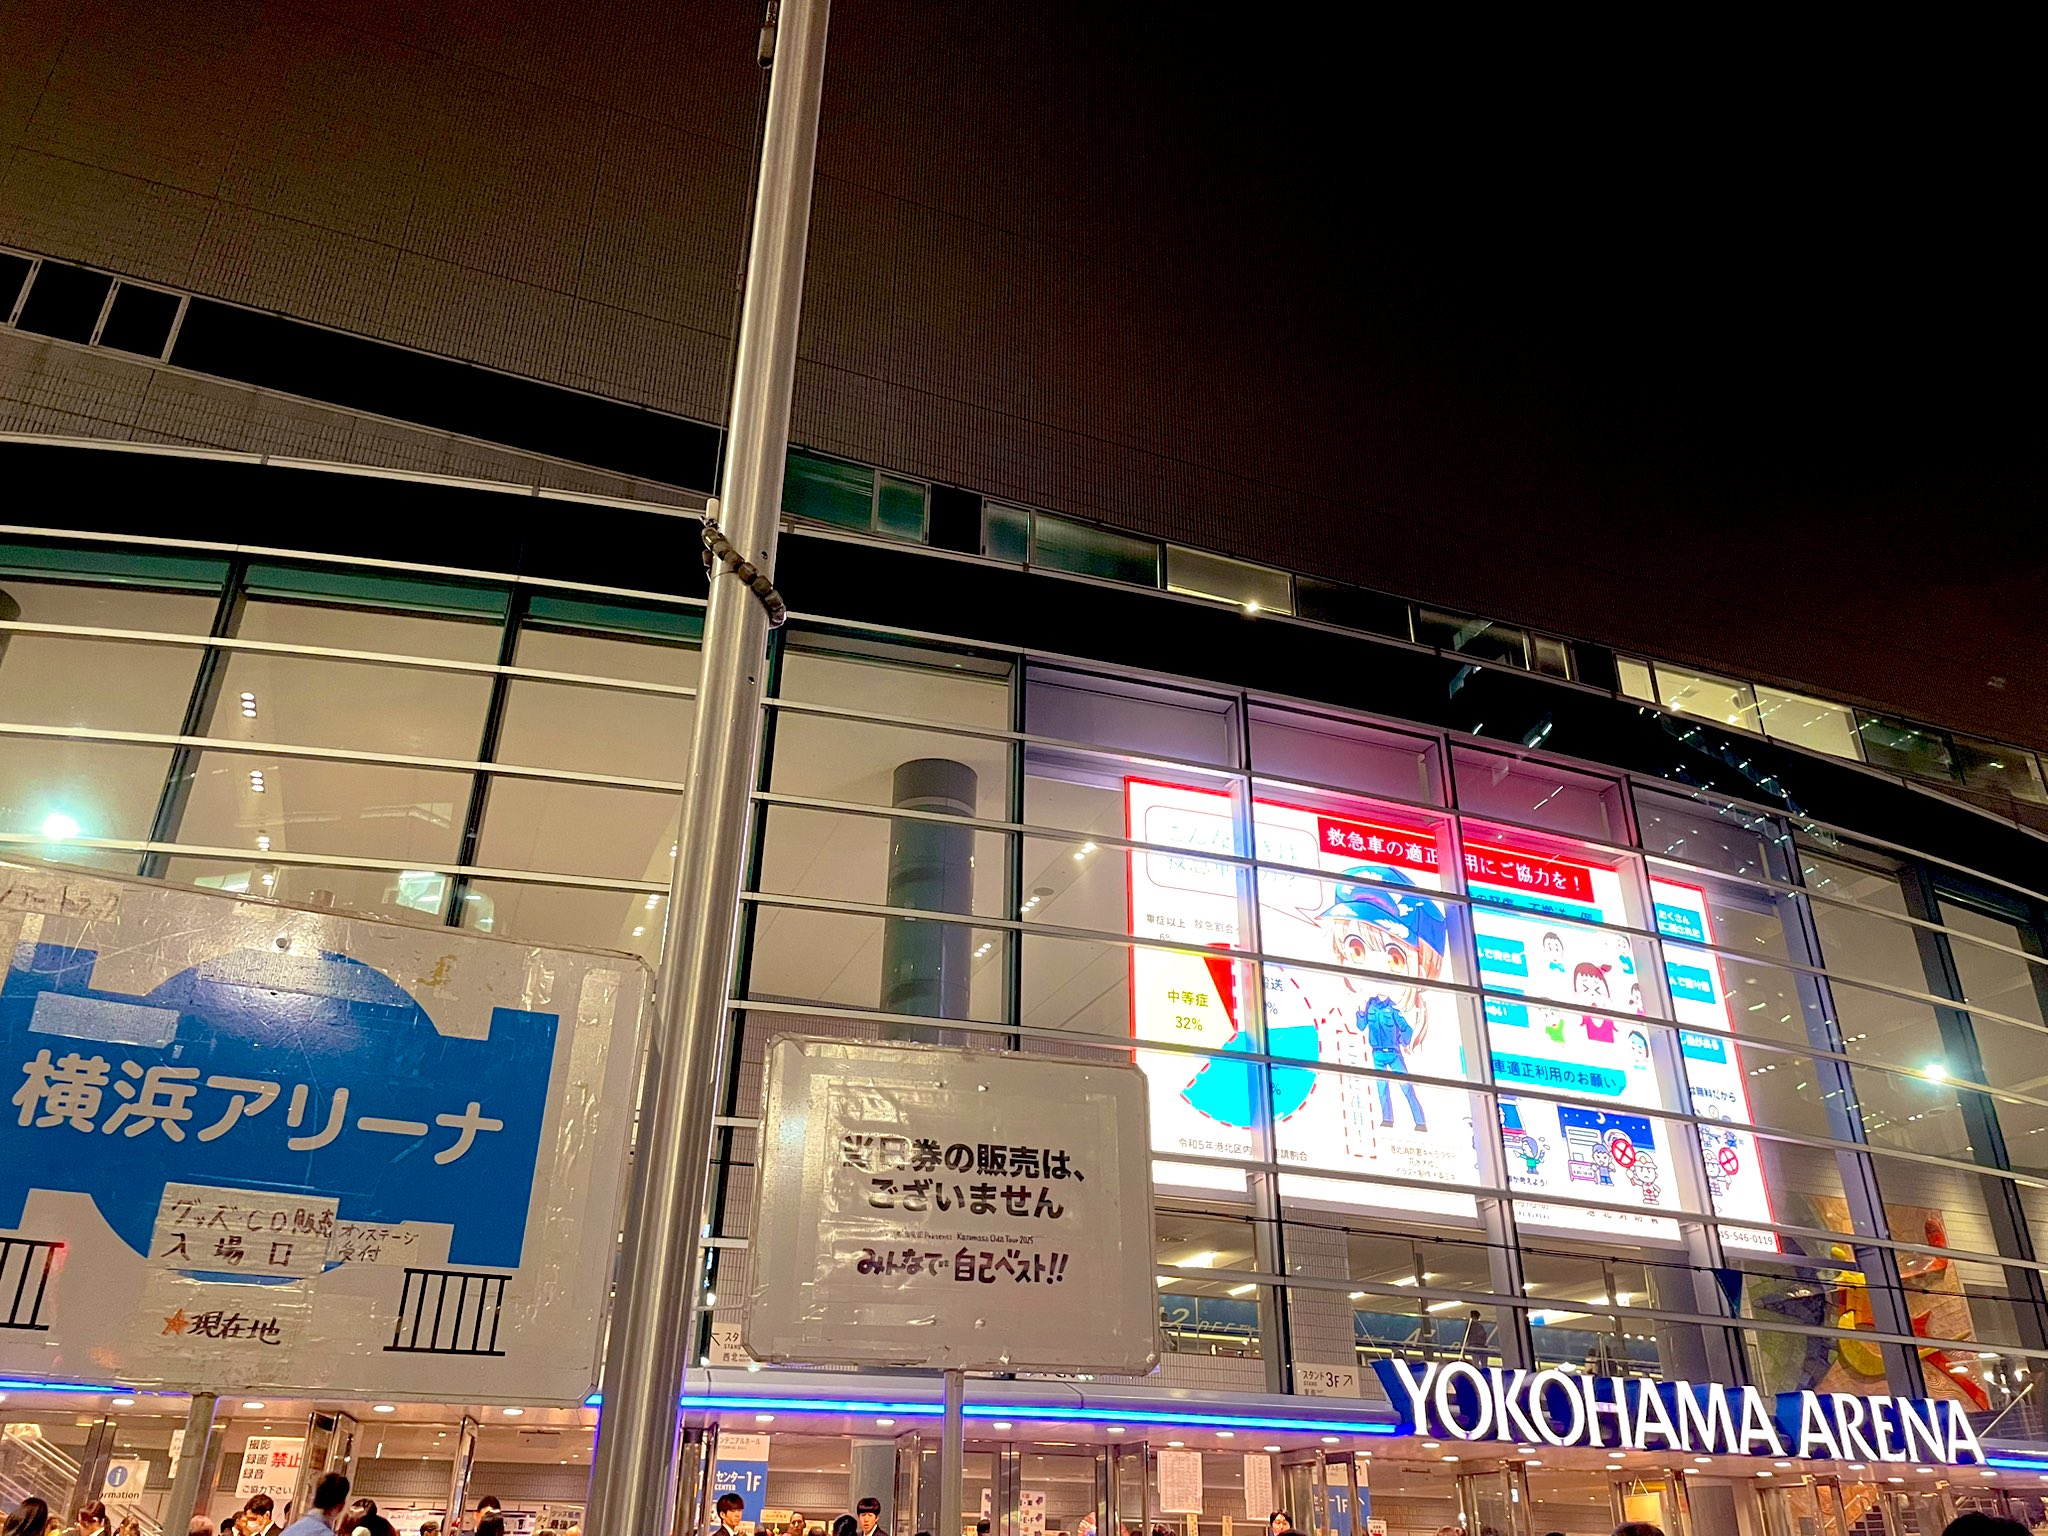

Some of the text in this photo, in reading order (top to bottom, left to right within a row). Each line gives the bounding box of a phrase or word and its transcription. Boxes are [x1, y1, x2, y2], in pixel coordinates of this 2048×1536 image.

[1167, 988, 1209, 1008] 中等症
[1175, 1015, 1203, 1031] 32%
[12, 1048, 504, 1166] 横浜アリーナ
[868, 1178, 1066, 1220] ございません
[338, 1224, 420, 1246] オンステージ
[160, 1232, 295, 1267] 入場口
[337, 1241, 382, 1263] 受付
[856, 1247, 950, 1277] みんなで
[187, 1310, 283, 1346] 現在地
[1303, 1370, 1340, 1388] スタンド 3F
[1389, 1358, 1988, 1466] YOKOHAMA ARENA
[270, 1452, 302, 1468] 禁止
[714, 1483, 736, 1491] CENTER
[716, 1470, 762, 1492] センター 1F
[1335, 1495, 1348, 1513] 1F
